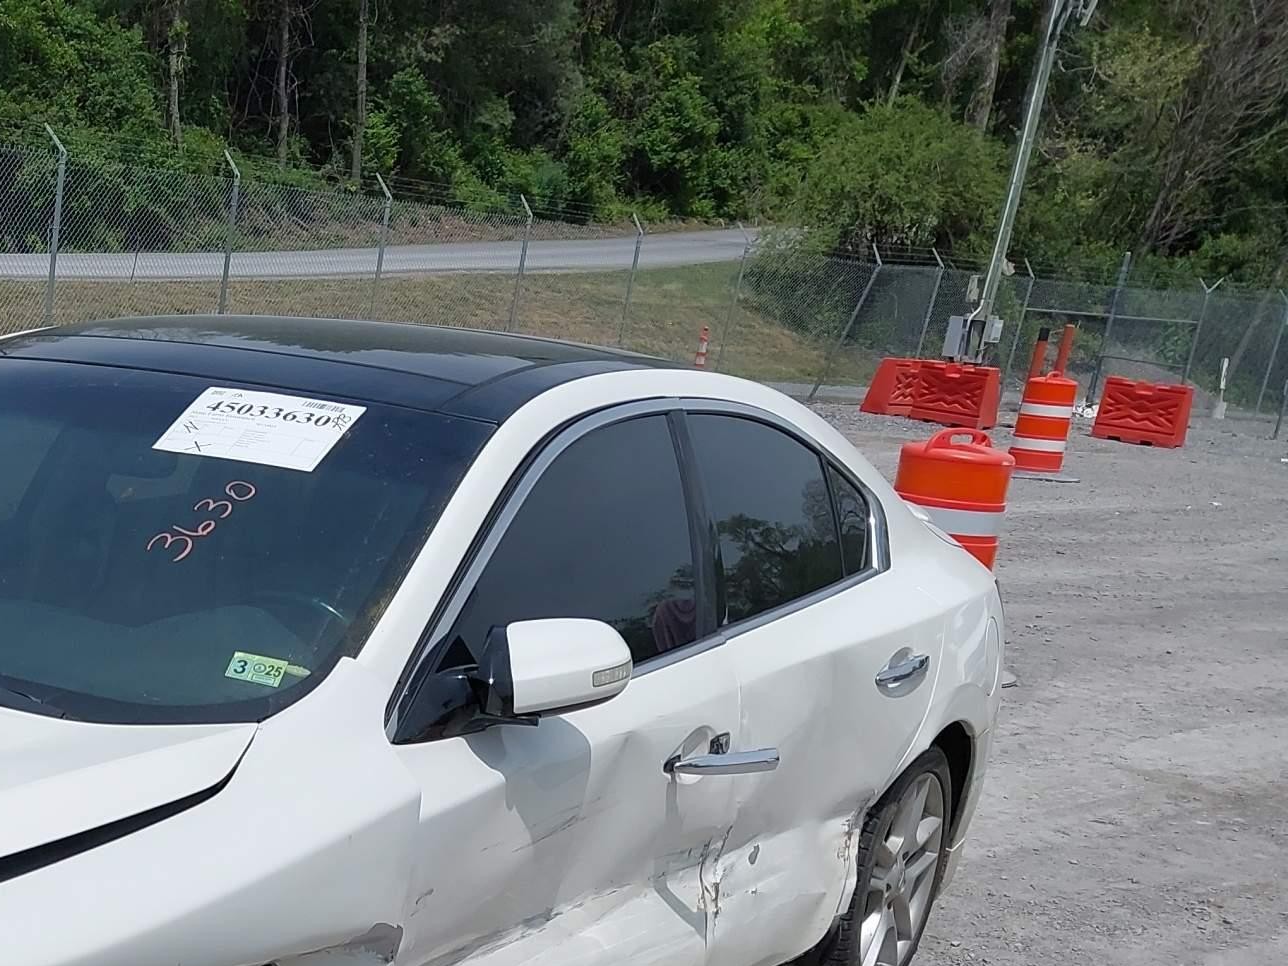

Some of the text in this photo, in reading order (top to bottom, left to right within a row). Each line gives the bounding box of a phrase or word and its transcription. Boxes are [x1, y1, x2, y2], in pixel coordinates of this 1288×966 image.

[206, 400, 331, 427] 45033630
[147, 480, 256, 562] 3630
[233, 659, 283, 678] 3 25
